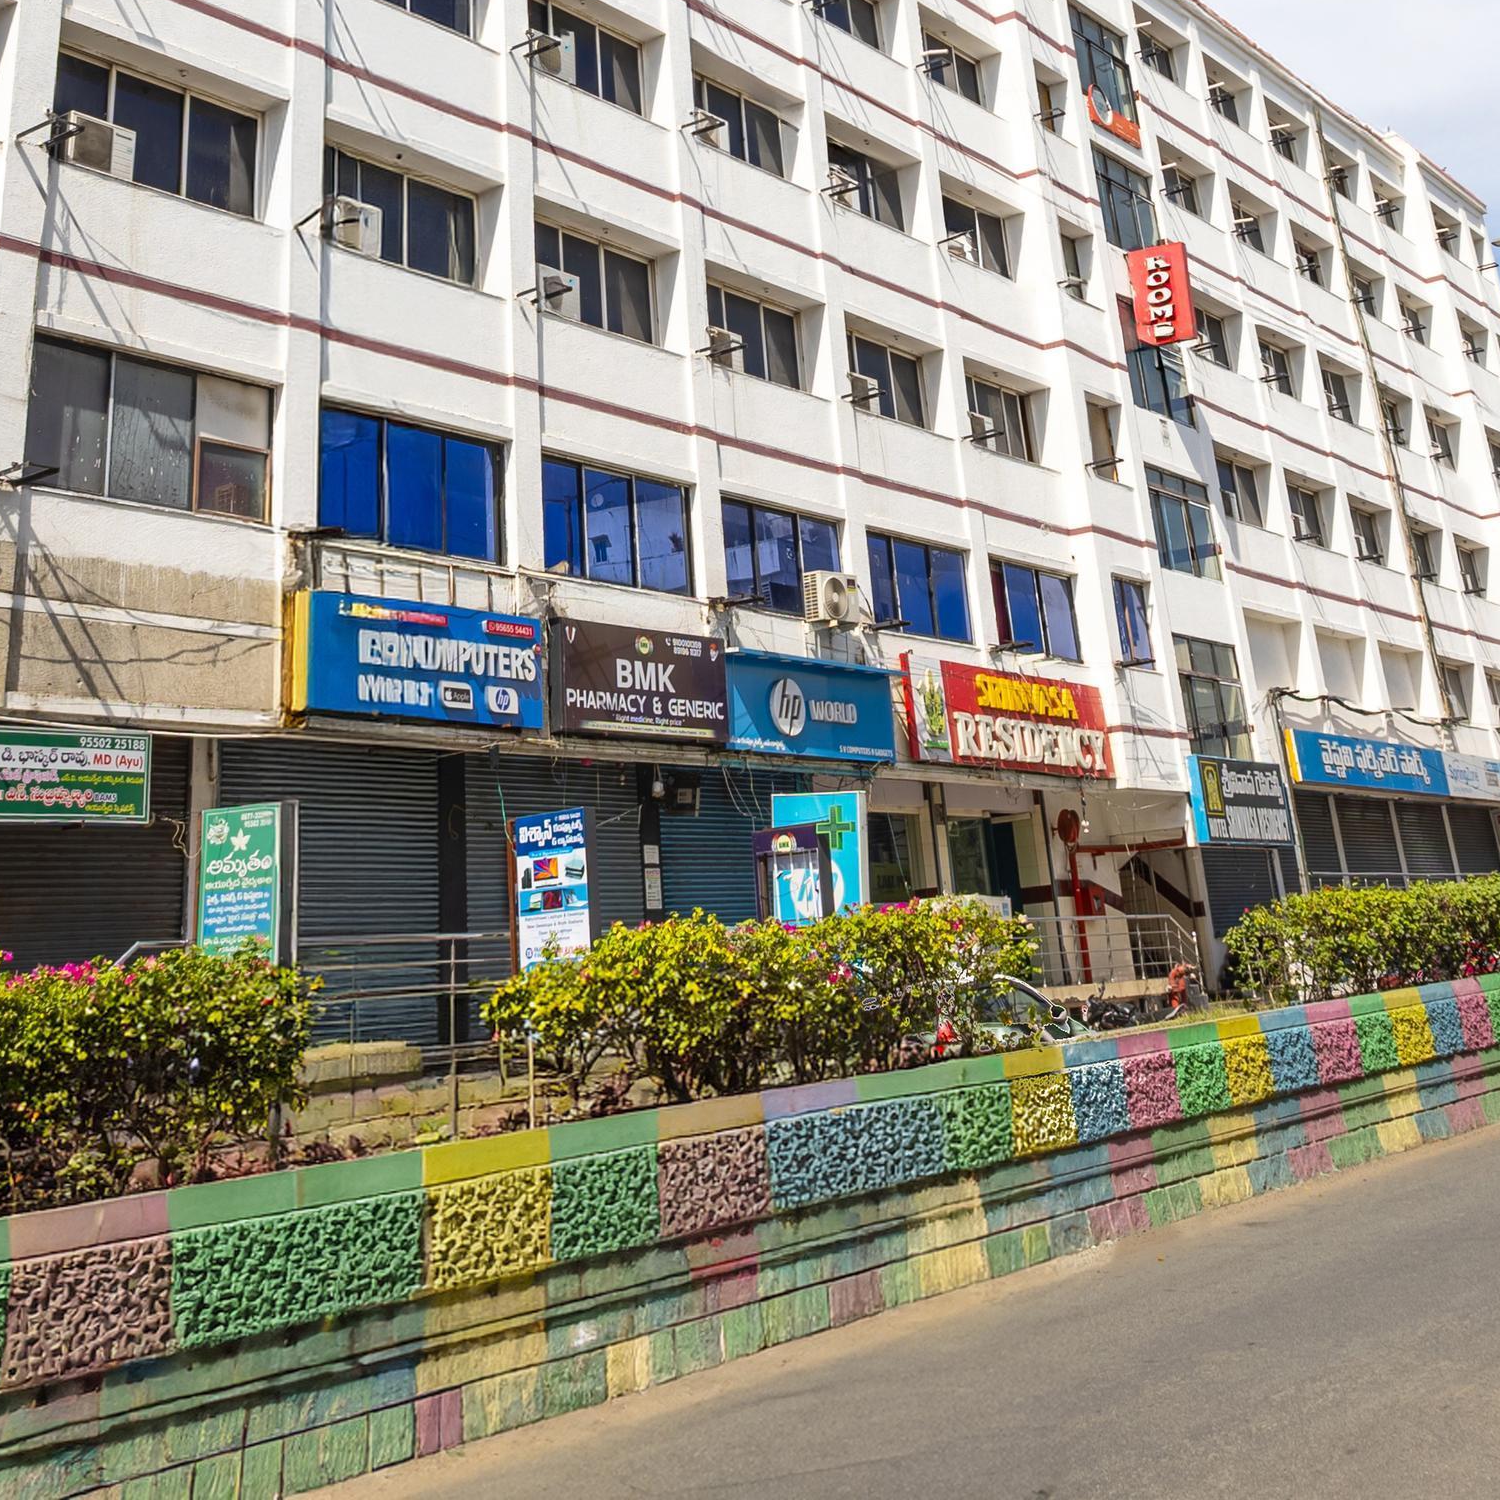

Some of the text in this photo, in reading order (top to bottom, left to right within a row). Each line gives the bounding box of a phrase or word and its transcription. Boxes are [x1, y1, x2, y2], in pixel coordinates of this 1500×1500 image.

[1145, 256, 1176, 339] ROOMS
[616, 658, 675, 693] BMK
[497, 689, 509, 711] hp
[566, 688, 724, 720] PHARMACY & GENERIC
[808, 700, 857, 724] WORLD
[79, 737, 146, 750] 95502 25188
[954, 711, 1107, 770] RESIDENCY
[93, 754, 112, 765] MD
[115, 755, 143, 769] (Ayu)
[206, 850, 272, 877] అమృతం
